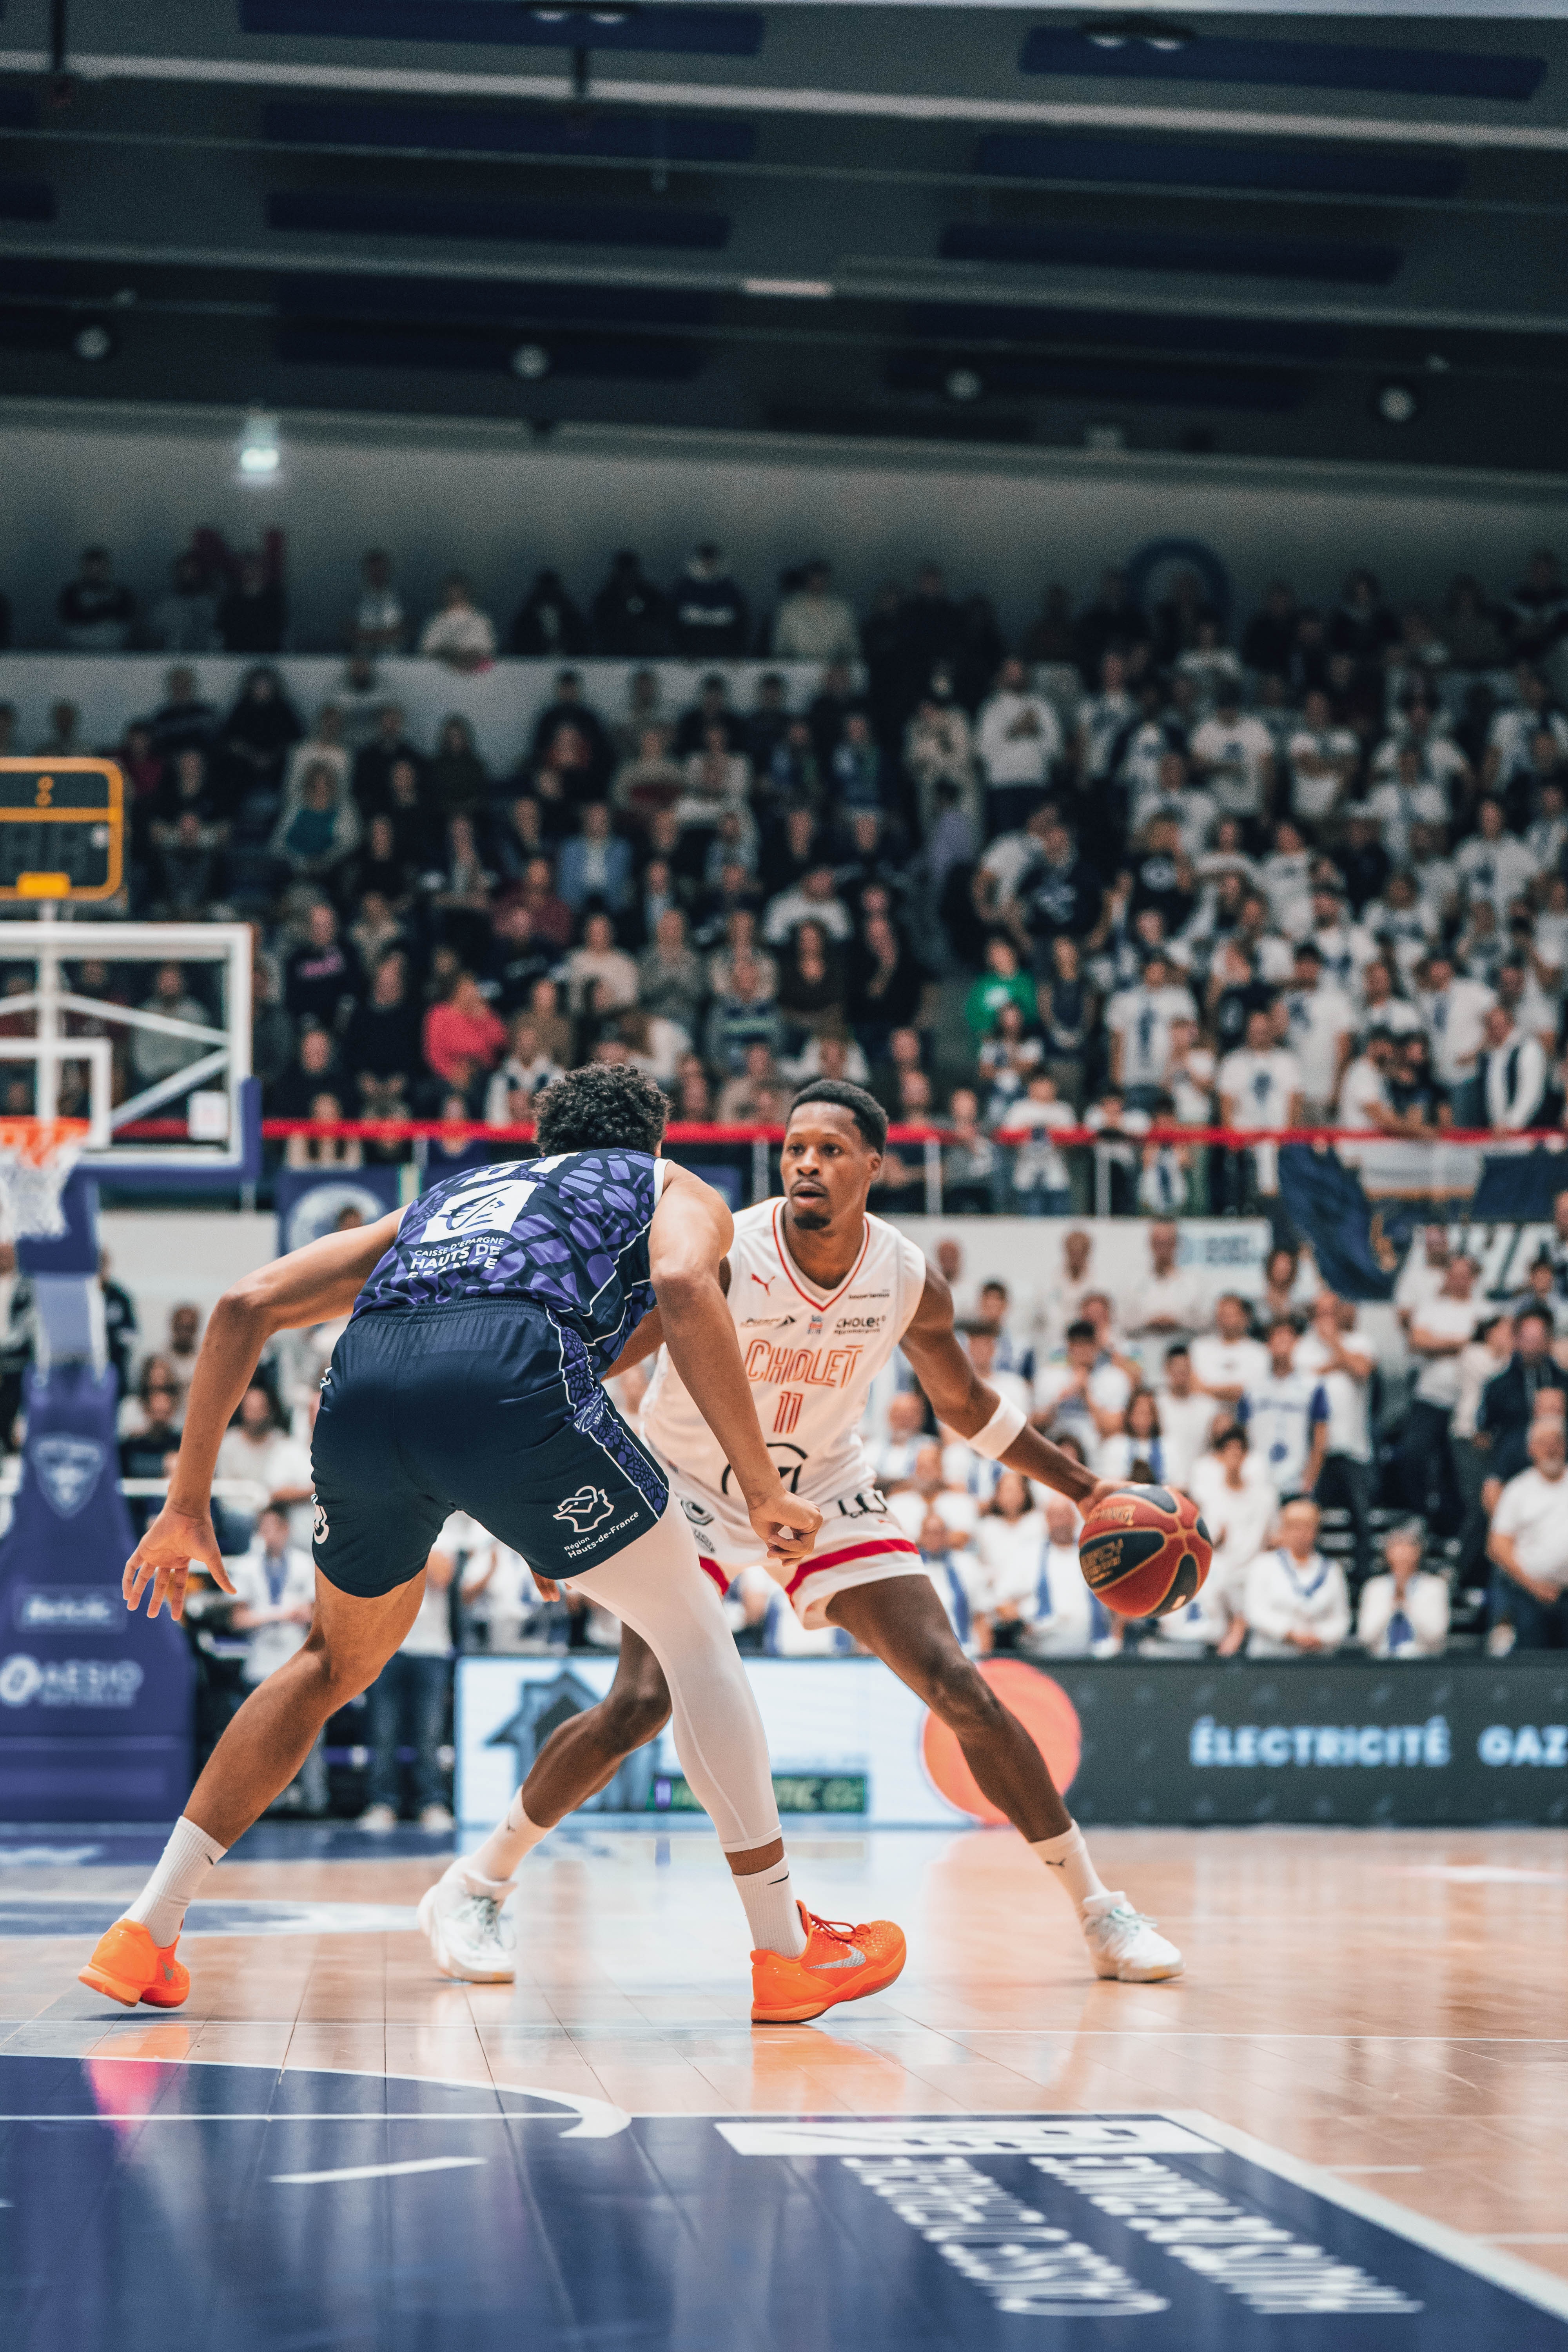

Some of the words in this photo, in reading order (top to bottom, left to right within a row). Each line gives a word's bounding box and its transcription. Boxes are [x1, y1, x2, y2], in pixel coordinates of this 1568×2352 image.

[410, 1246, 470, 1269] HAUTS
[475, 1244, 501, 1256] DE
[414, 1247, 448, 1257] CAISSE
[745, 1339, 864, 1388] CHOLET
[773, 1390, 804, 1434] 11
[564, 1537, 590, 1551] Région
[568, 1512, 639, 1558] Hauts-de-France
[1190, 1715, 1451, 1766] ÉLECTRICITÉ
[1478, 1725, 1568, 1766] GAZ
